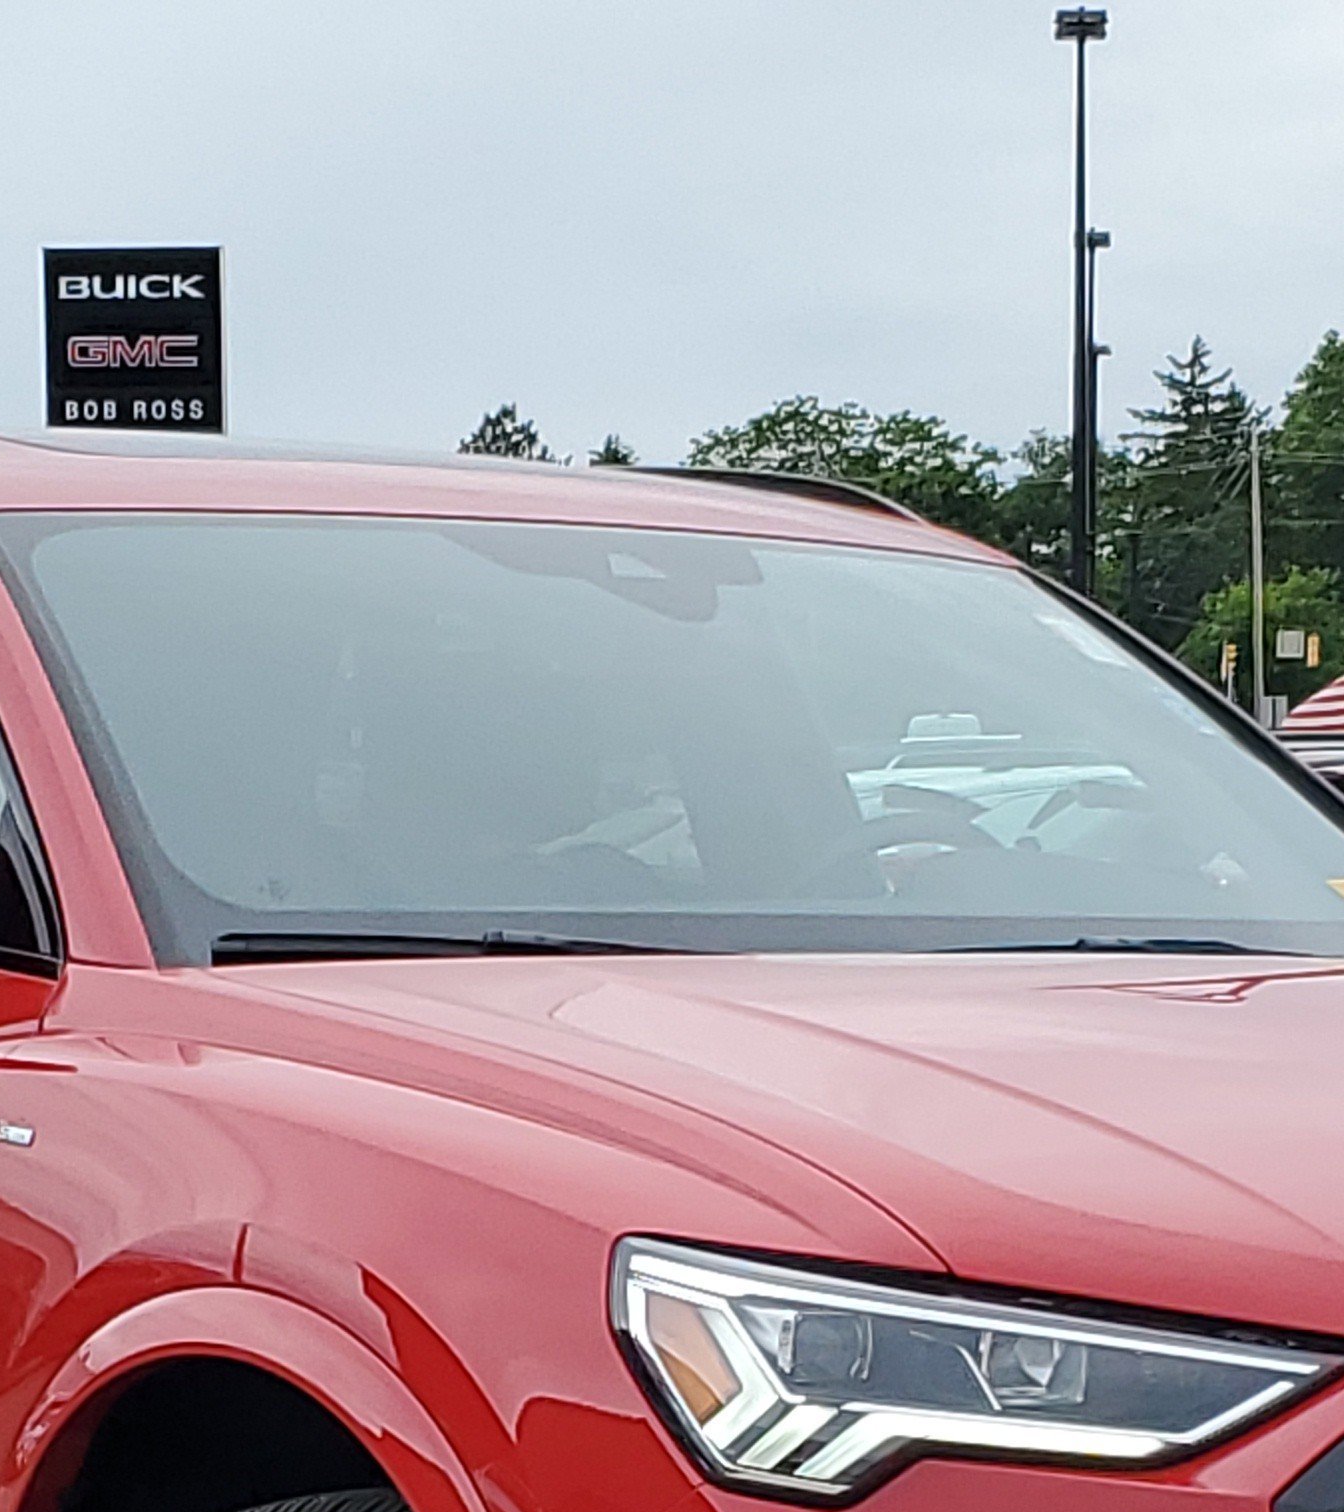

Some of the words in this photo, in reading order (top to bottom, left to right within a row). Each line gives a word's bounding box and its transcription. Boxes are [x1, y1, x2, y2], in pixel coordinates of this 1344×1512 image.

[58, 274, 205, 299] BUICK
[67, 335, 199, 368] GMC
[65, 399, 117, 420] BOB
[133, 399, 204, 421] ROSS
